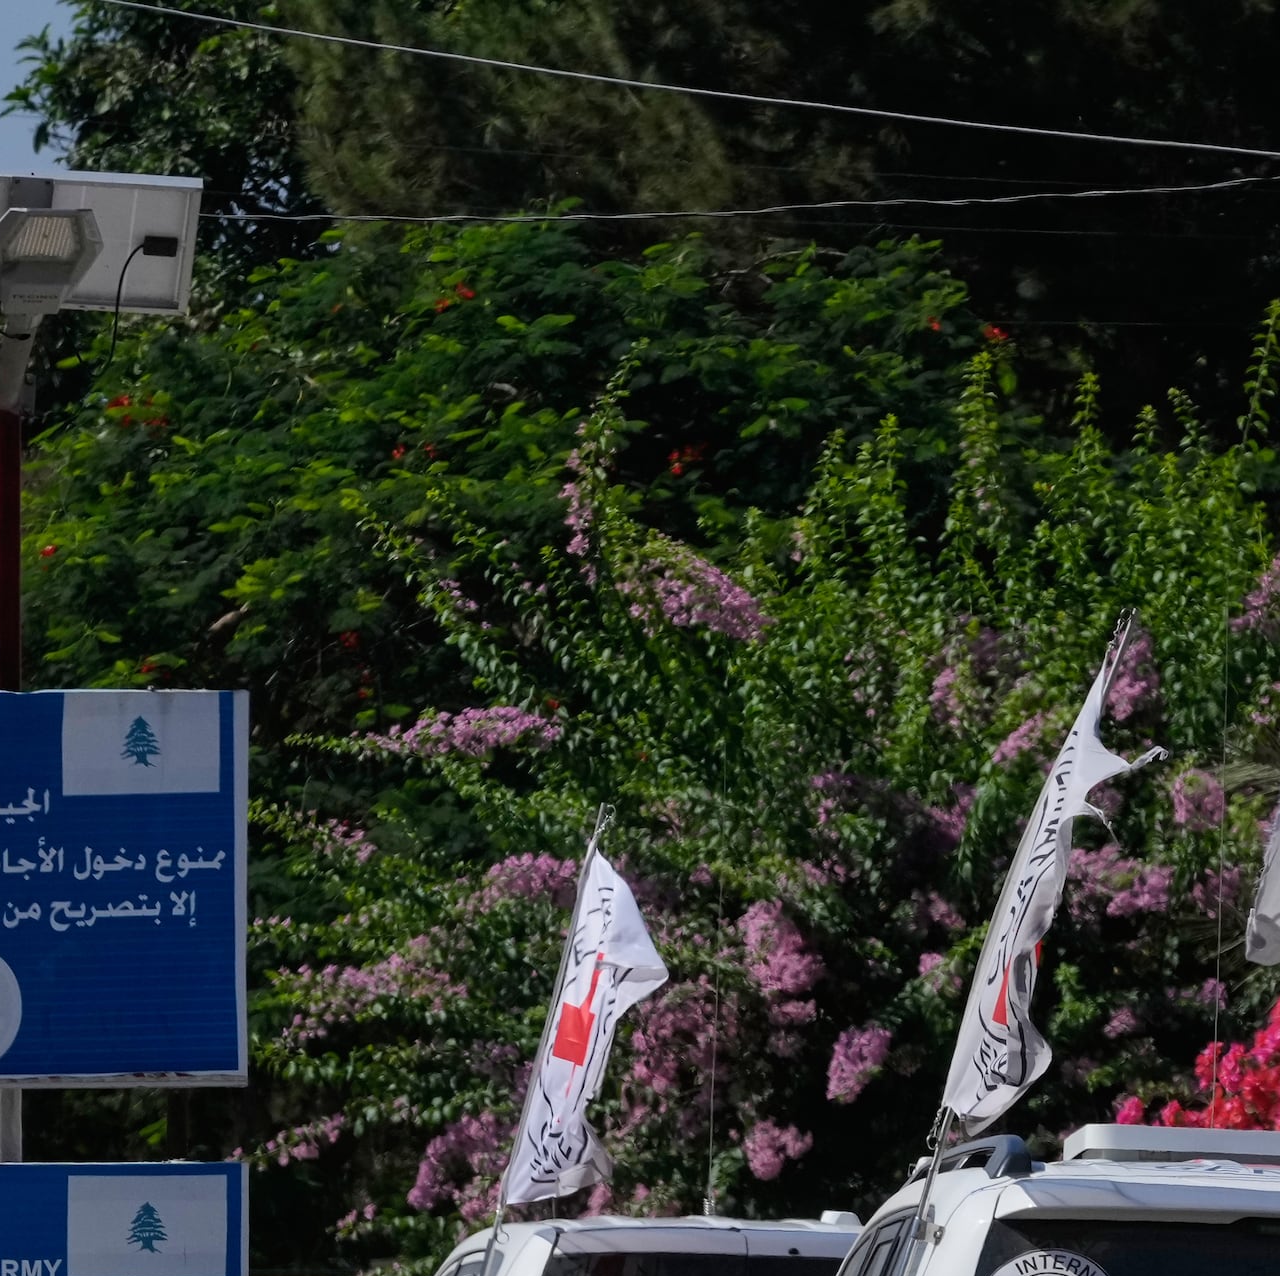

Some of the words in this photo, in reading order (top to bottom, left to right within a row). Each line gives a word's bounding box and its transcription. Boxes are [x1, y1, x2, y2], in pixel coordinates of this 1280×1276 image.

[73, 846, 146, 880] دخول
[155, 847, 226, 883] ممنوع
[3, 902, 42, 928] من
[49, 894, 161, 932] بتصريح
[169, 890, 196, 927] إلا
